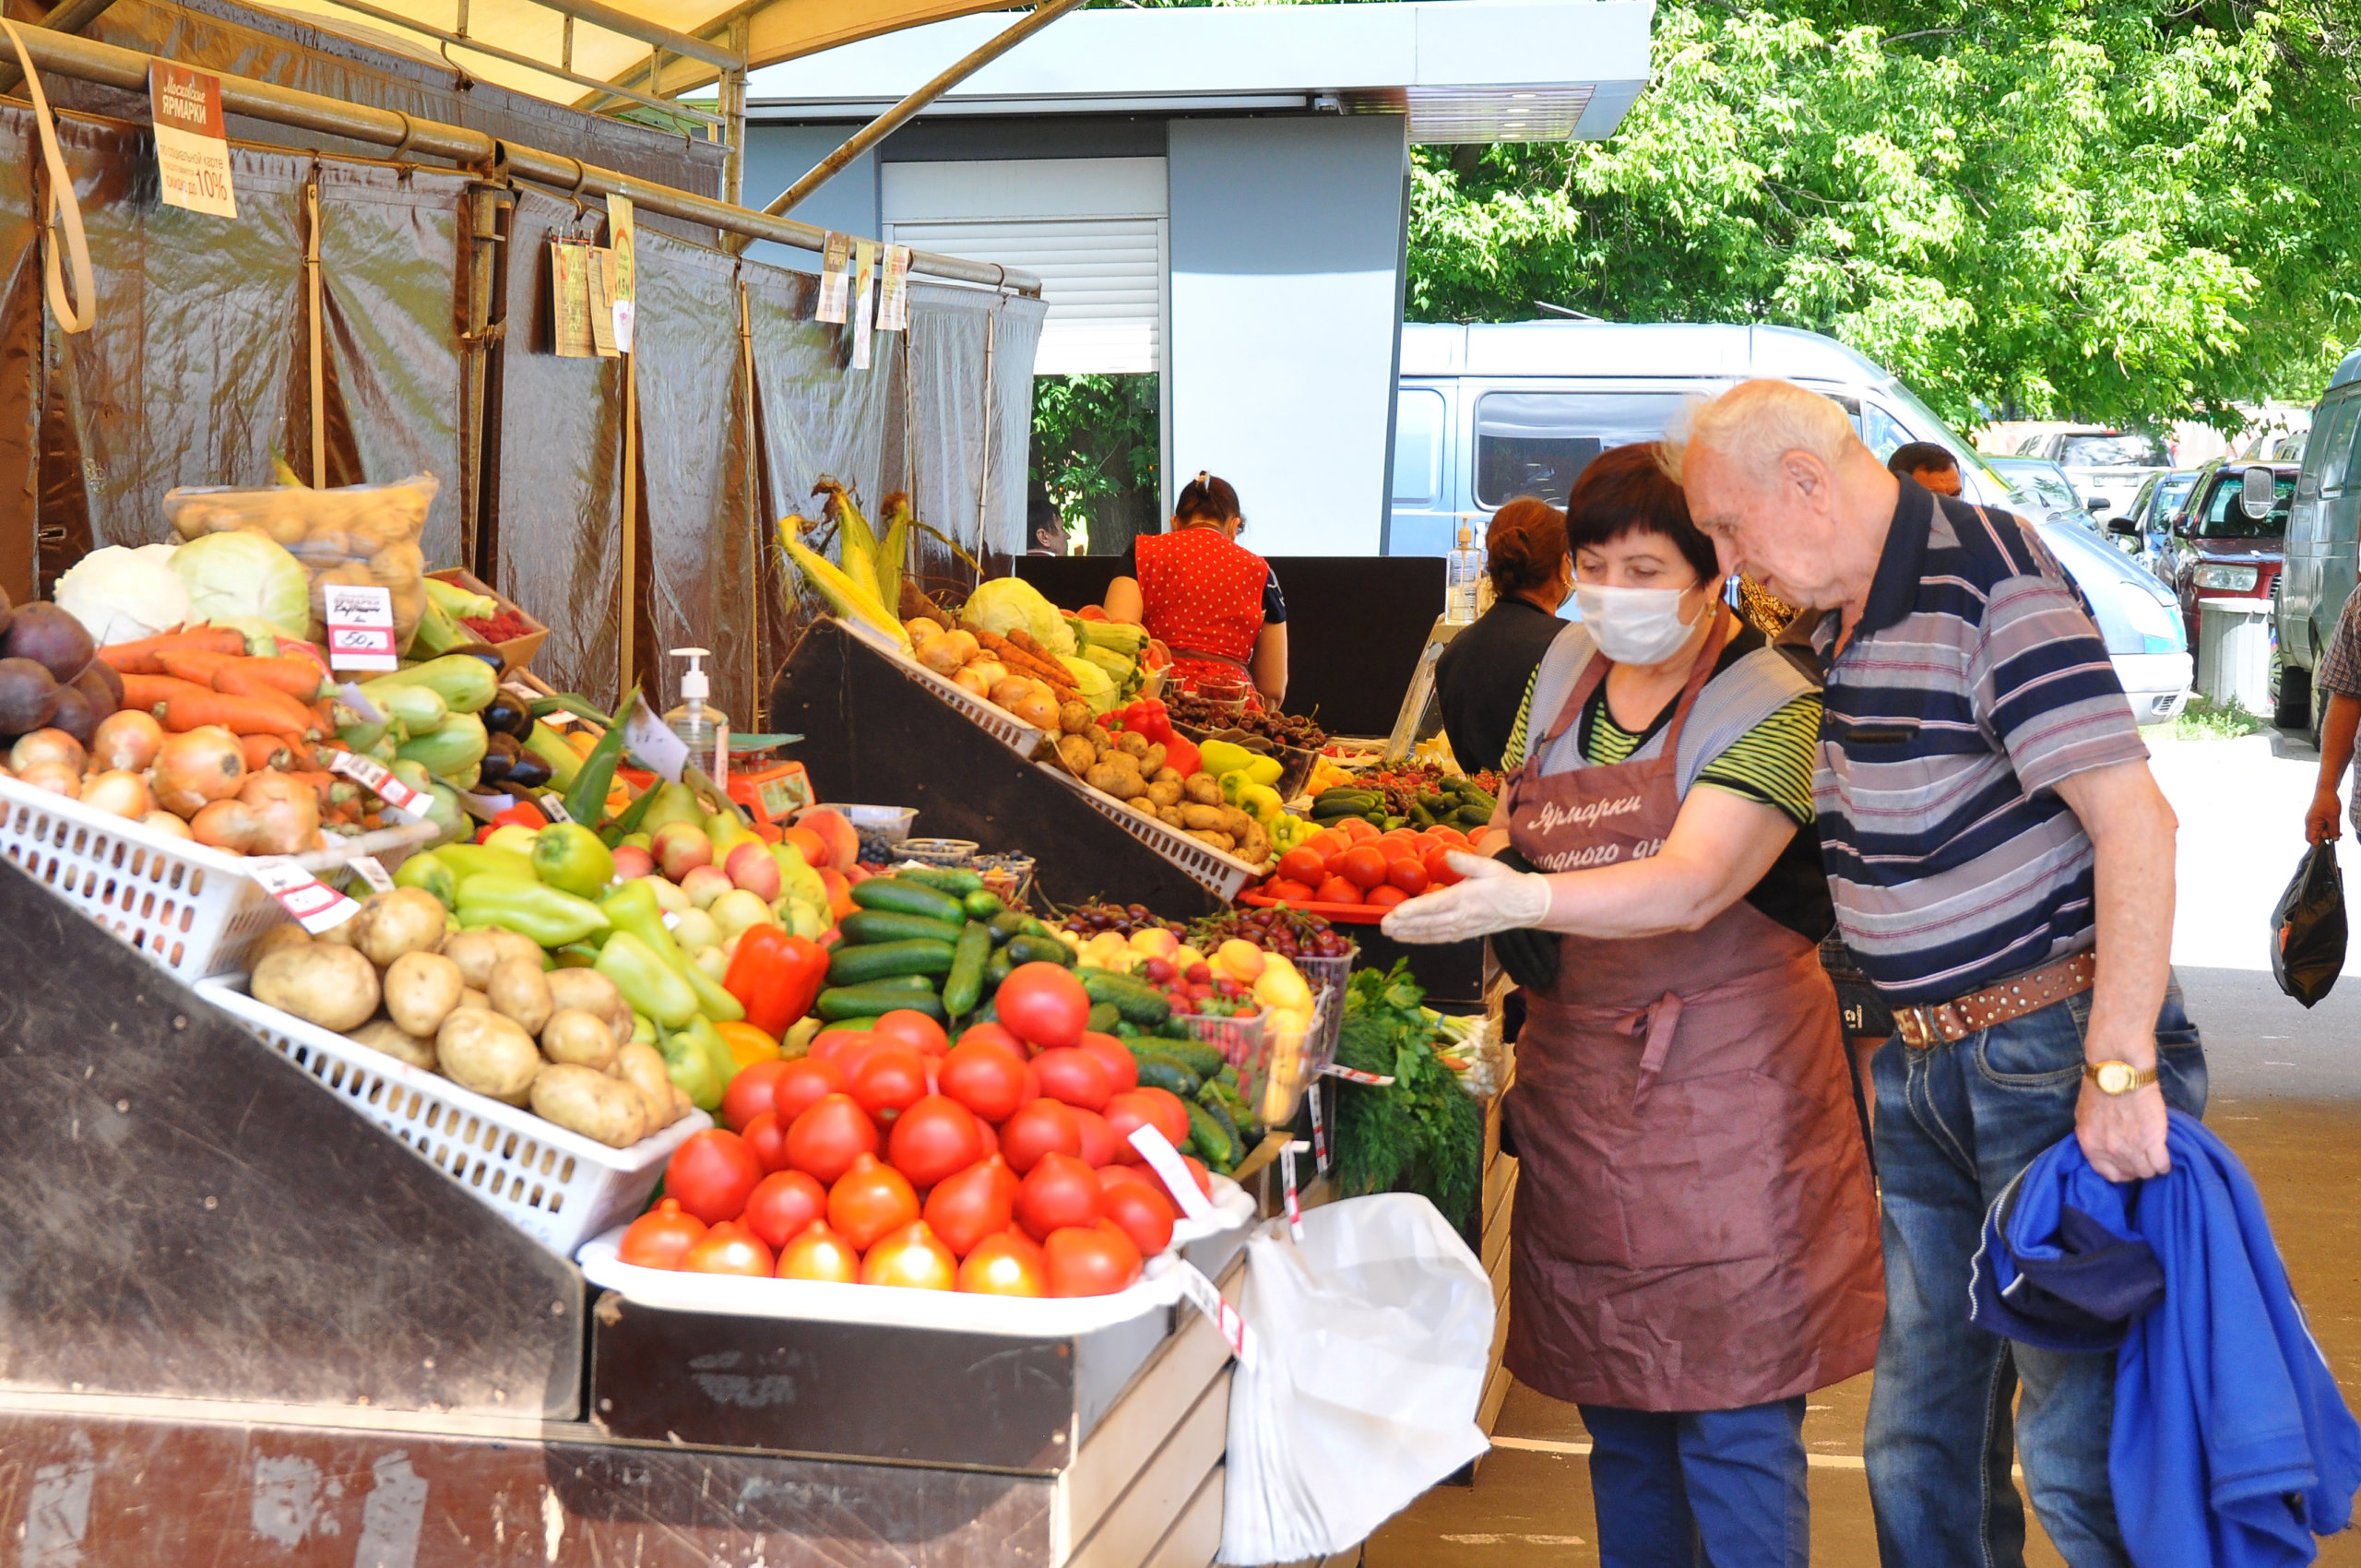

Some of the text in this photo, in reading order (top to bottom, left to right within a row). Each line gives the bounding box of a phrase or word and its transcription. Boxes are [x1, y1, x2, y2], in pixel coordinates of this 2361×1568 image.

[163, 74, 207, 103] Московские
[162, 95, 207, 125] ЯРМАРКИ
[203, 156, 224, 170] карте
[196, 170, 227, 201] 10%
[1527, 795, 1642, 836] Ярмарки
[1631, 837, 1667, 860] дн
